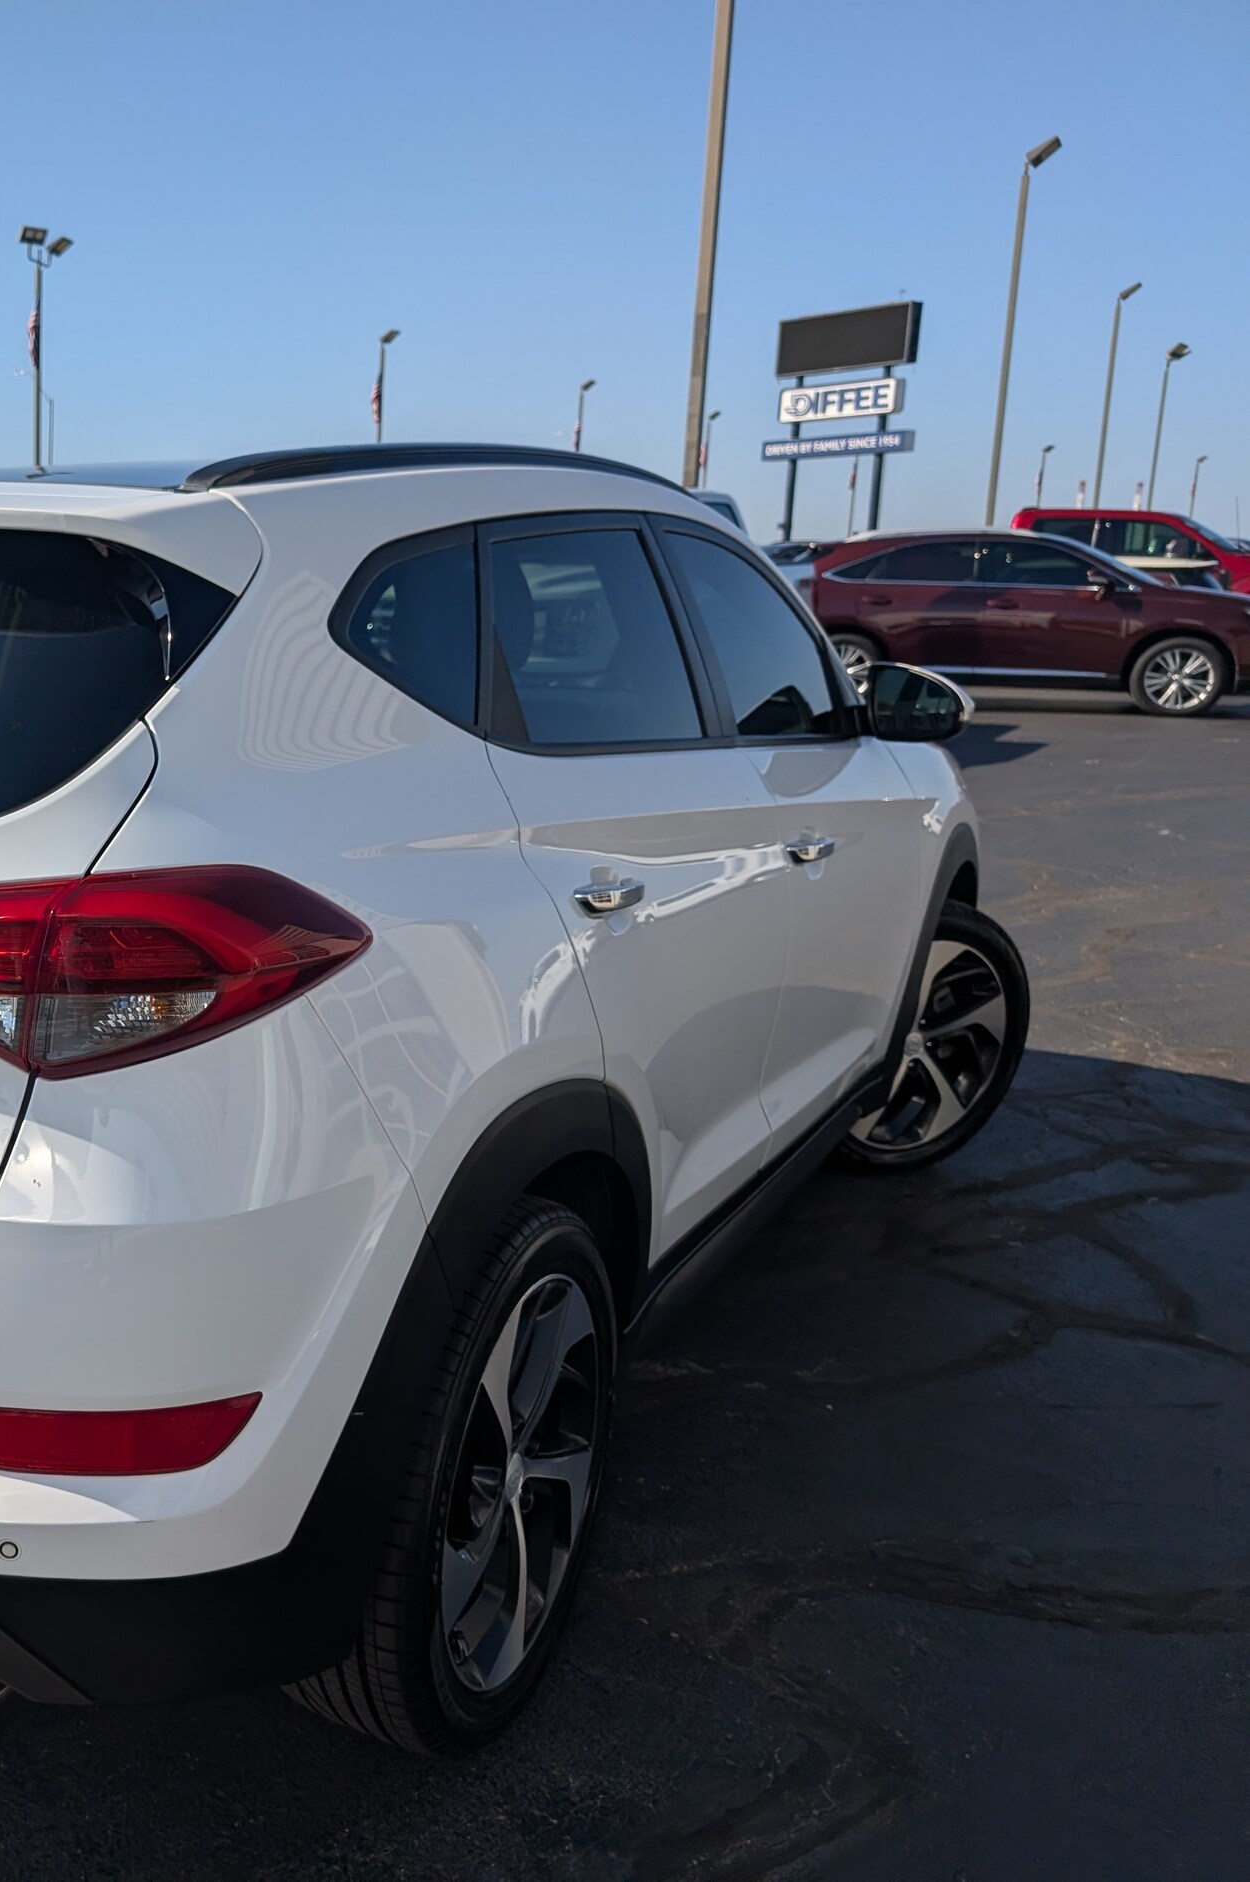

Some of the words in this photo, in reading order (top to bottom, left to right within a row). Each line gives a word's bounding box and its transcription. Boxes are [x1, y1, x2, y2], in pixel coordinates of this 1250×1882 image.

[785, 384, 890, 416] DIFFEE
[765, 443, 799, 457] DRIVEN
[800, 441, 812, 454] BY
[813, 439, 846, 453] FAMILY
[848, 436, 877, 450] SINCE
